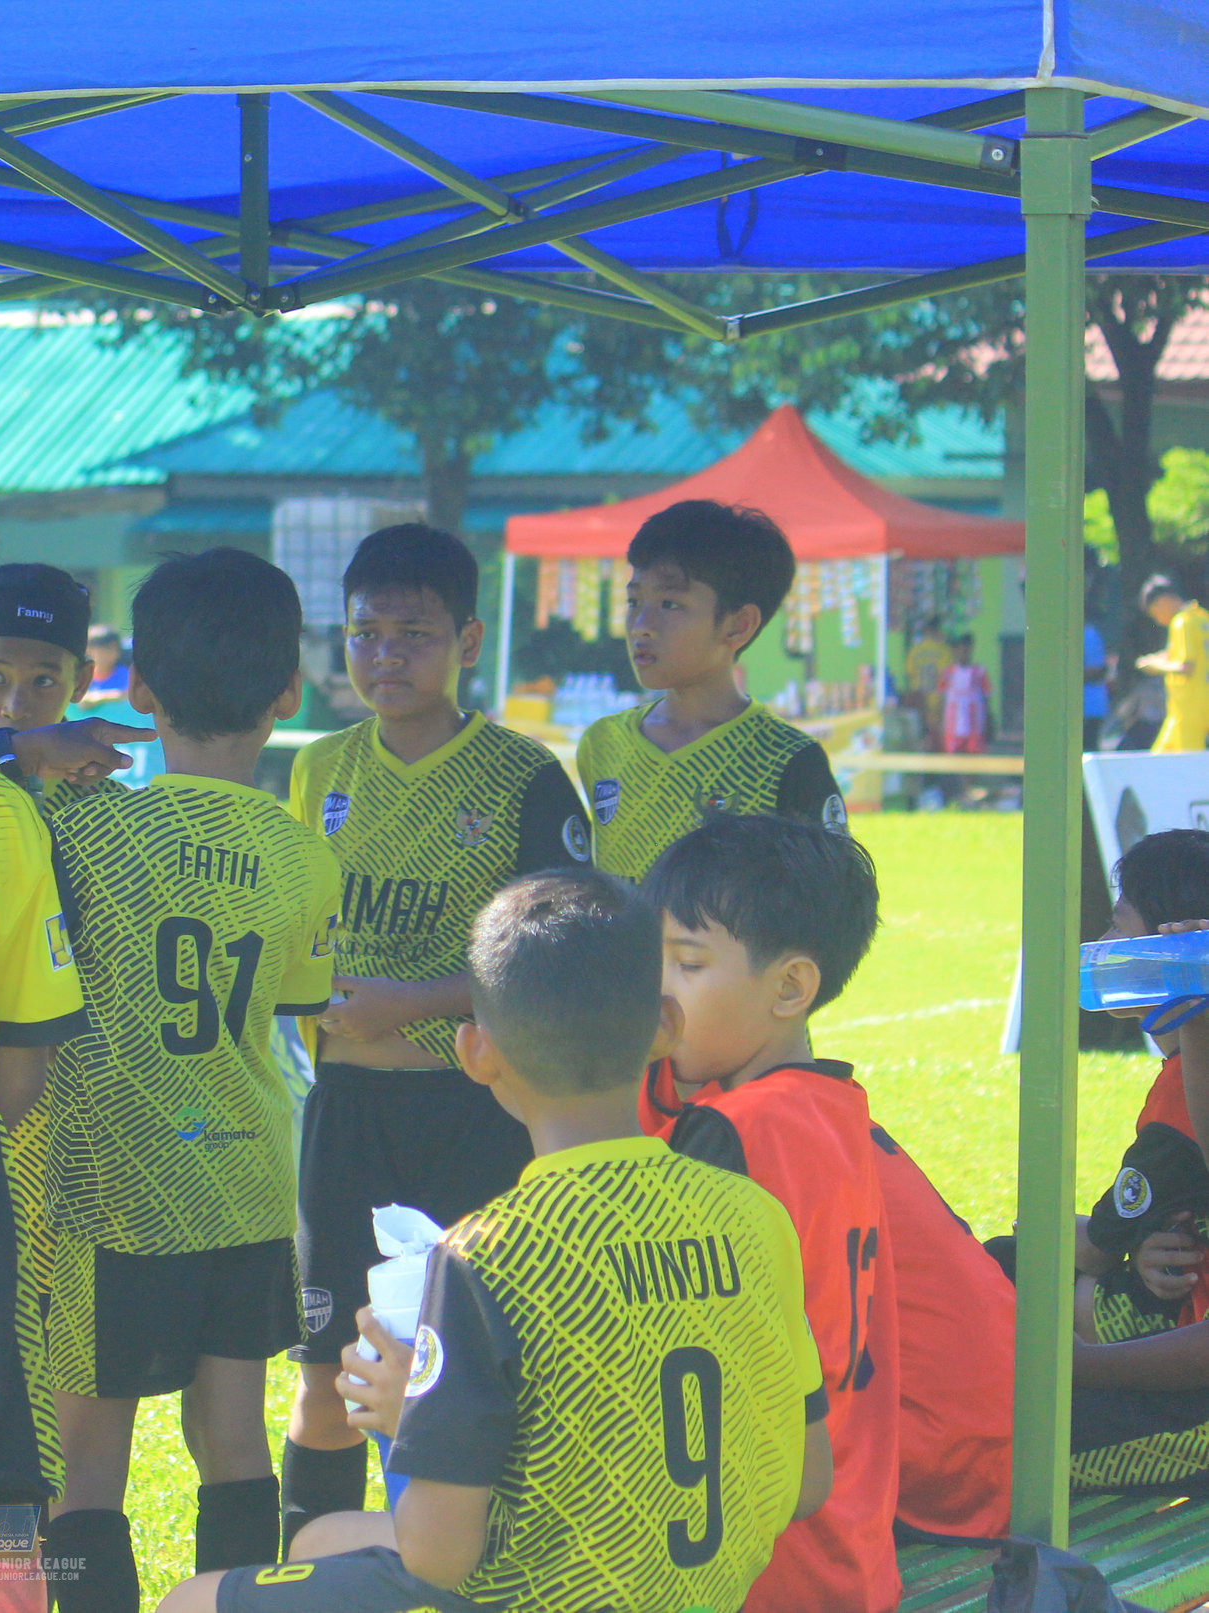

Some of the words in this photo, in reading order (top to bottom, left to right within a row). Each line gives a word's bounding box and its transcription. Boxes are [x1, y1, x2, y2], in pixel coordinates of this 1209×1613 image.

[17, 606, 54, 623] Fanny
[178, 840, 261, 889] FATIH
[340, 870, 449, 935] IMAH
[156, 916, 265, 1056] 91
[603, 1234, 741, 1306] WINDU
[659, 1346, 724, 1570] 9
